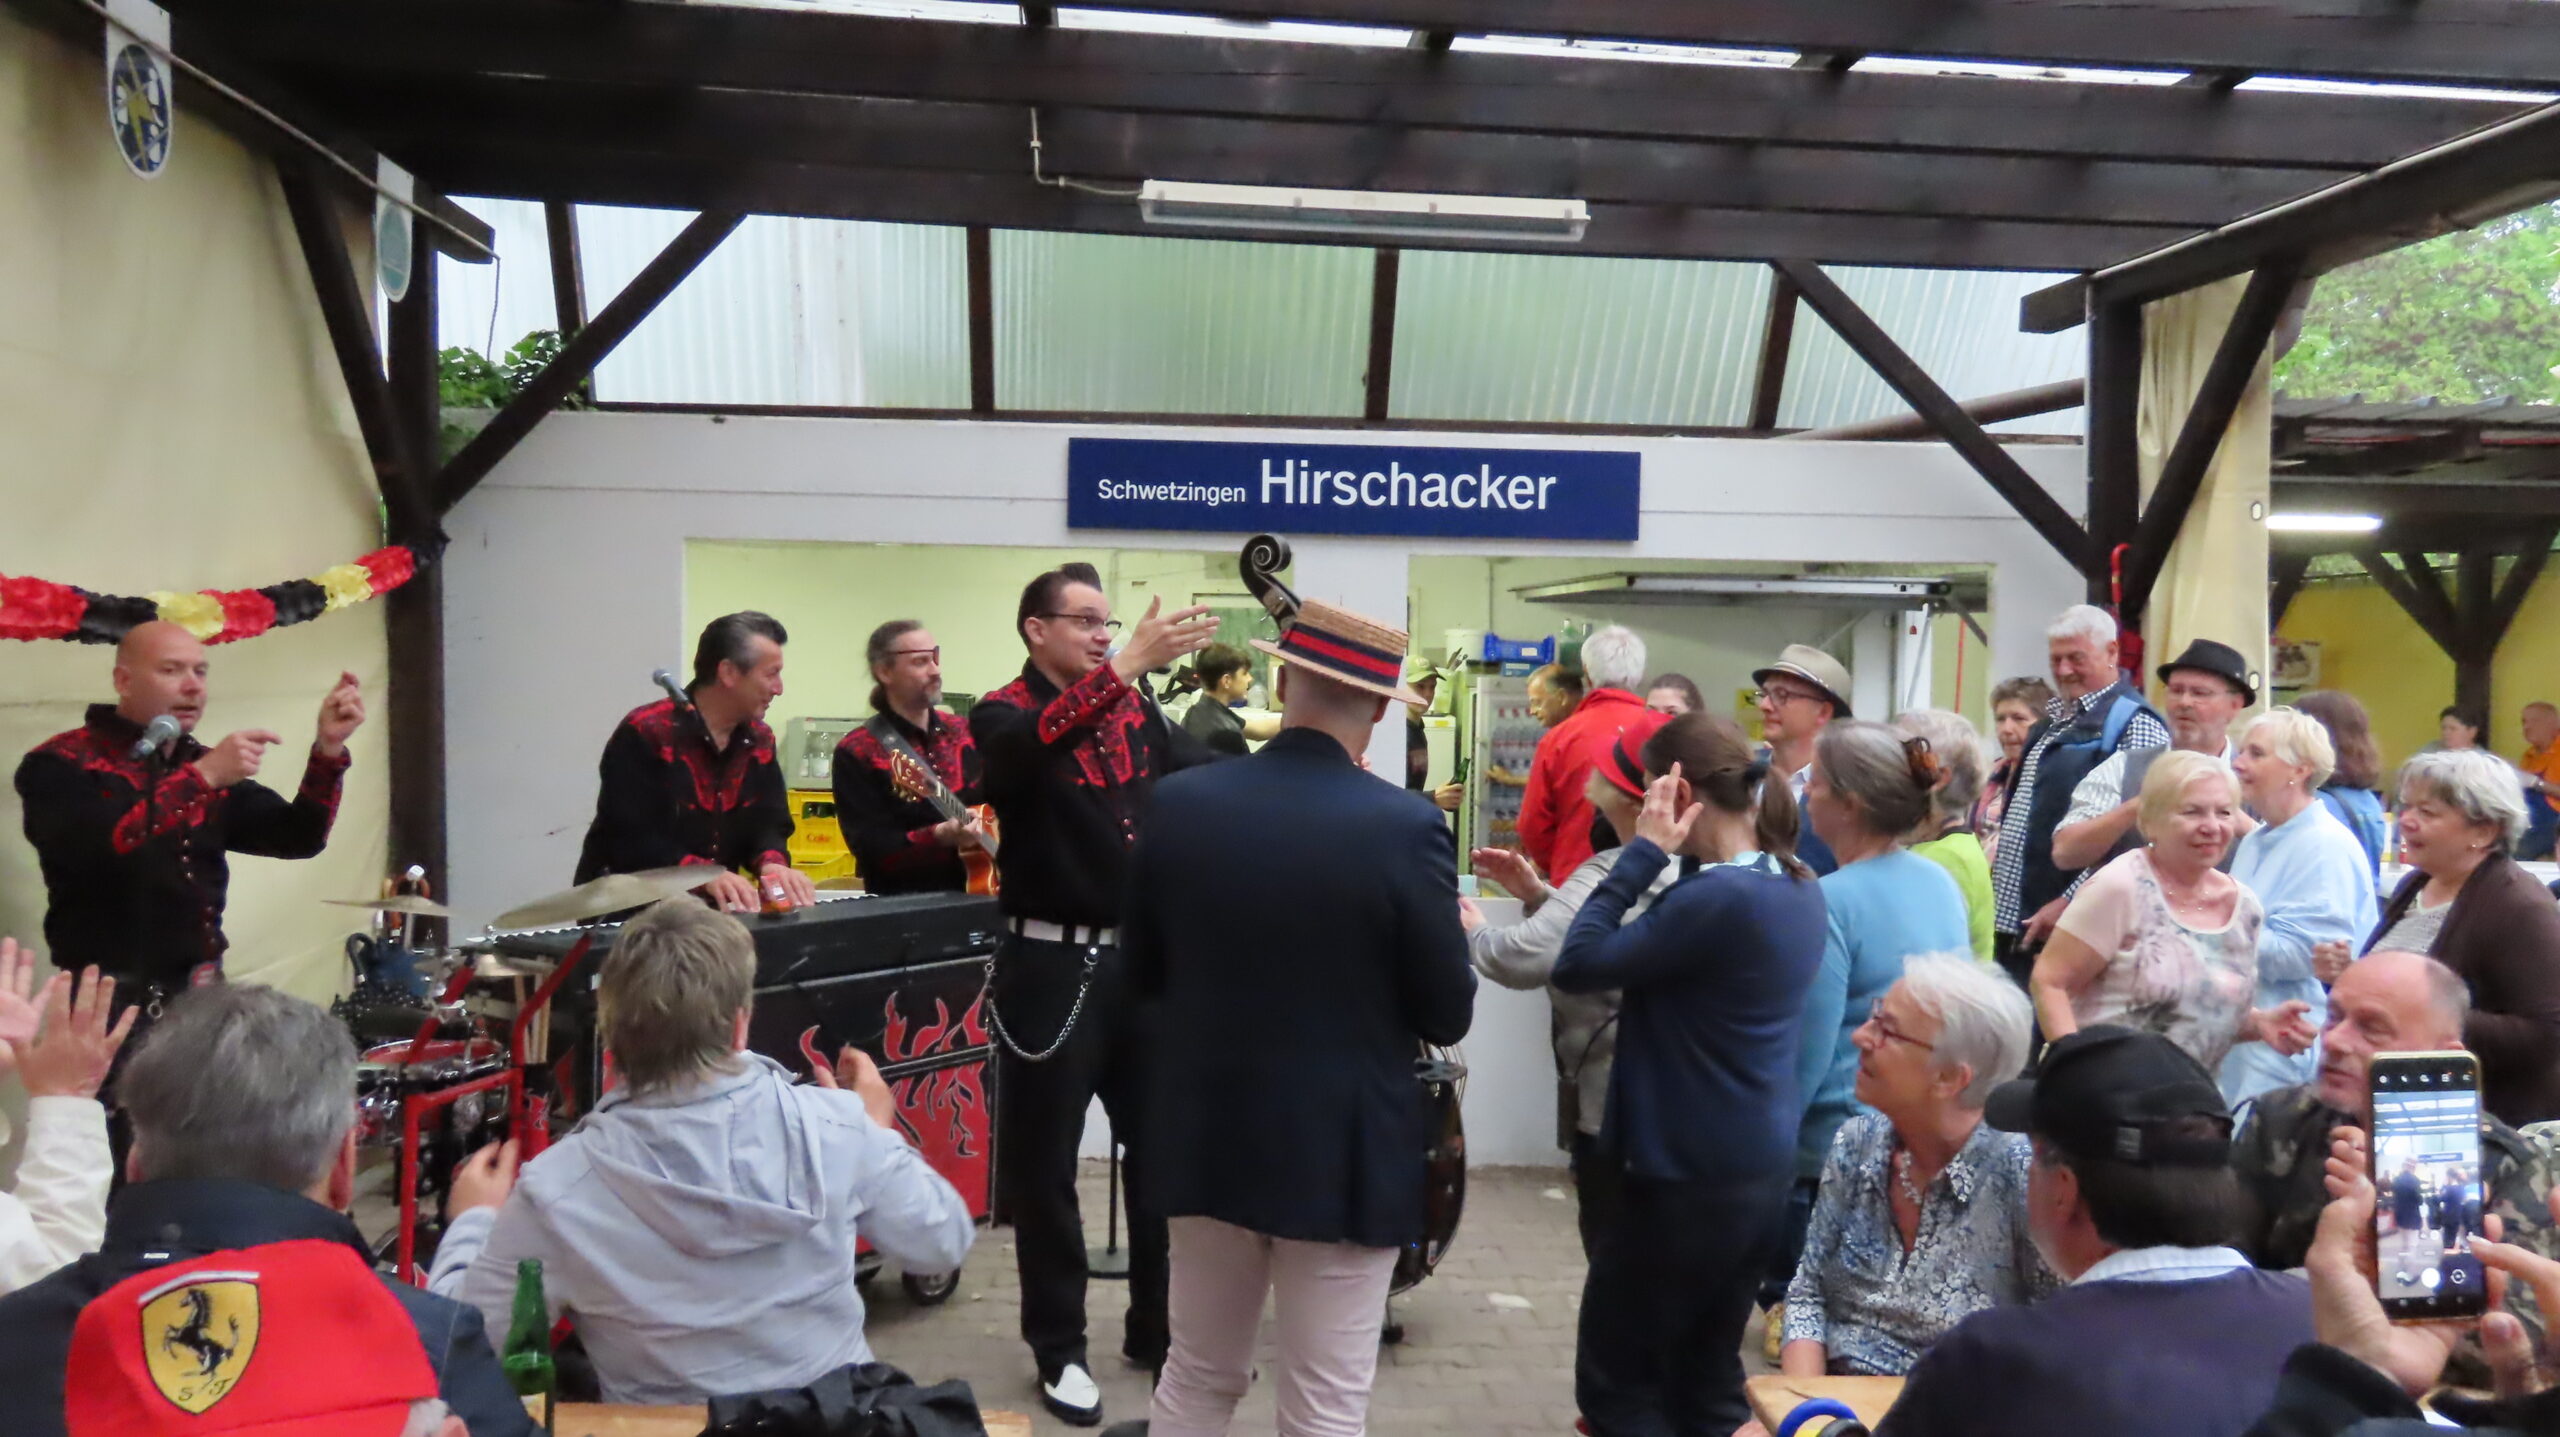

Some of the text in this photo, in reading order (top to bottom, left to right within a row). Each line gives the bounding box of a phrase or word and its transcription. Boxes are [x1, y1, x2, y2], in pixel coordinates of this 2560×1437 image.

[1098, 458, 1556, 510] Schwetzingen Hirschacker
[178, 1386, 193, 1401] S
